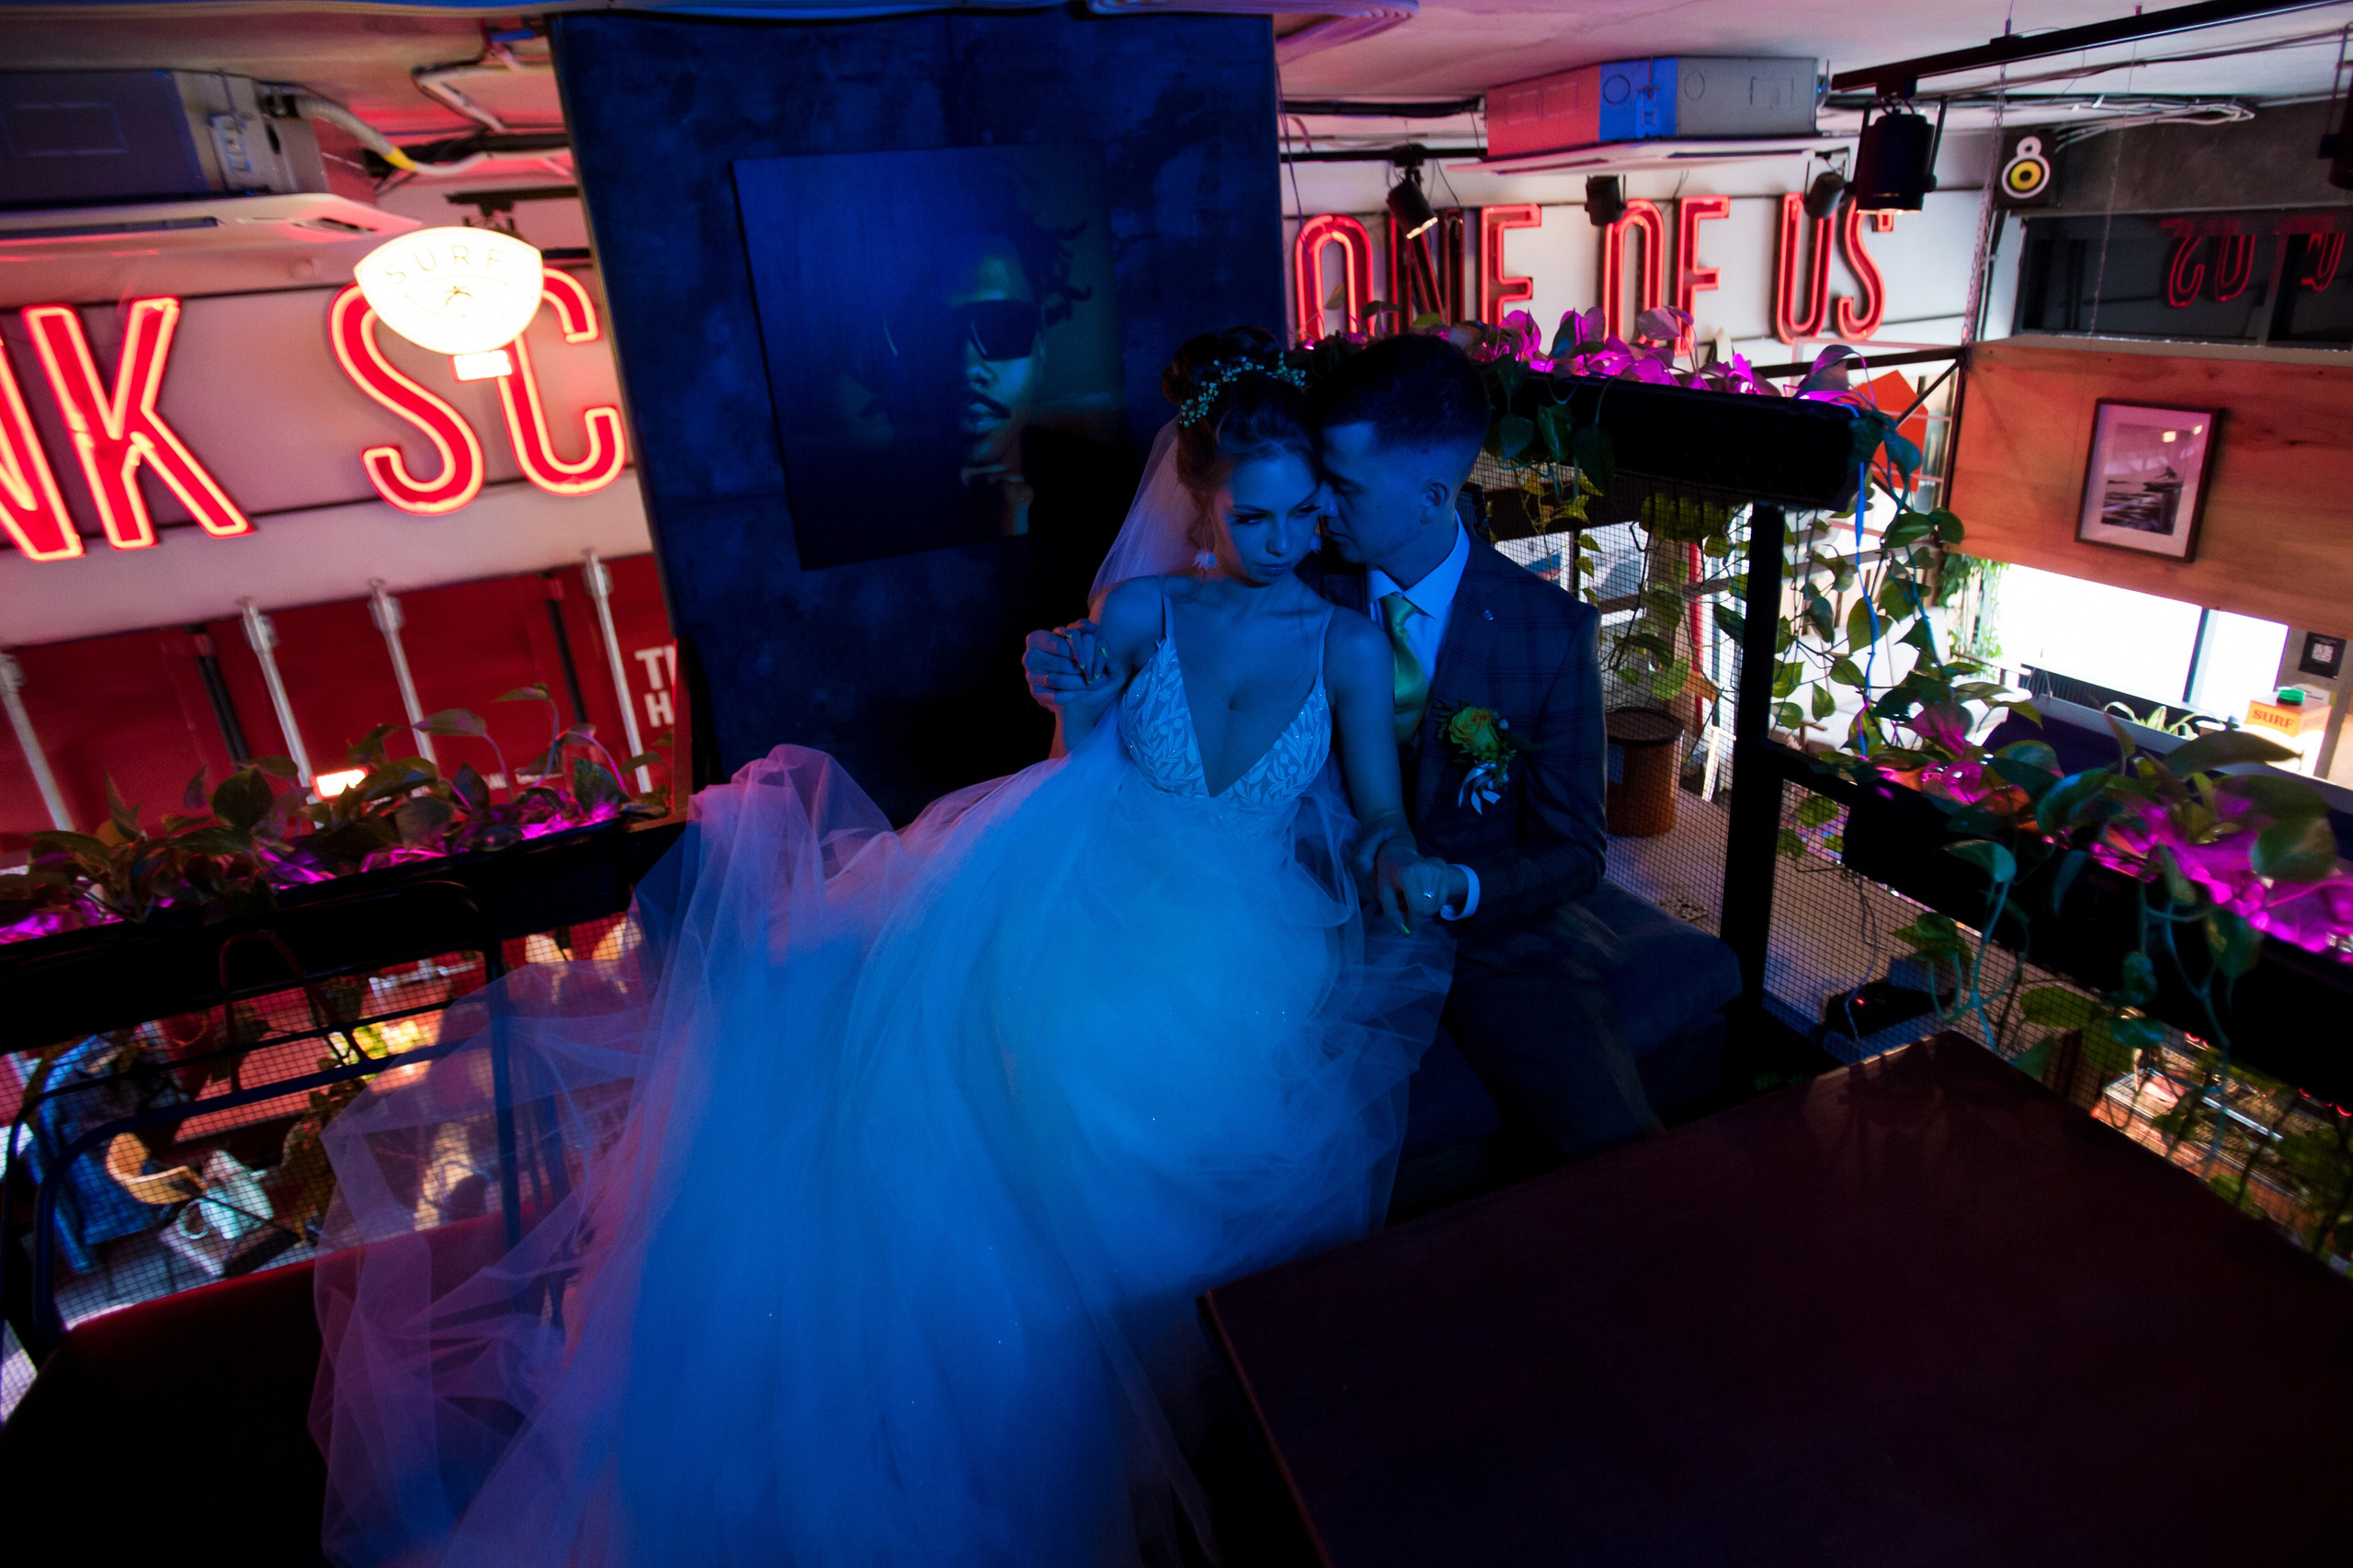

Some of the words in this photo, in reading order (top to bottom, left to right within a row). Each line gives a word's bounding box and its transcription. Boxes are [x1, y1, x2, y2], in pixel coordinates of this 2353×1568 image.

[383, 244, 505, 285] SURF
[1295, 203, 1542, 341] ONE
[1602, 195, 1731, 358] OF
[1776, 191, 1894, 347] US
[2253, 710, 2294, 728] SURF
